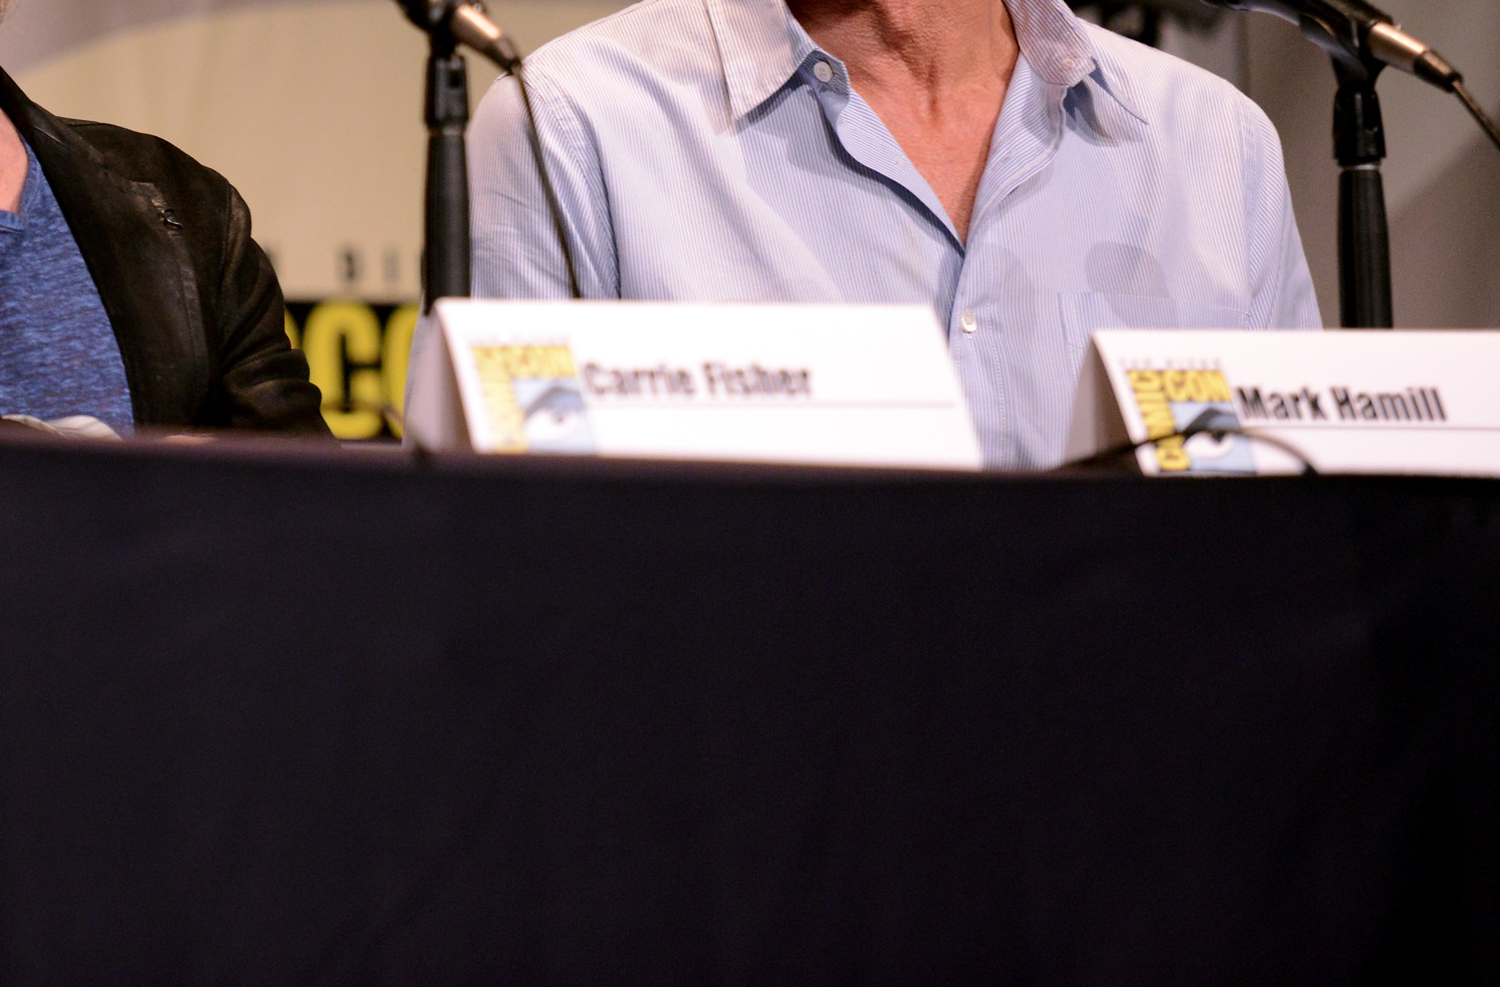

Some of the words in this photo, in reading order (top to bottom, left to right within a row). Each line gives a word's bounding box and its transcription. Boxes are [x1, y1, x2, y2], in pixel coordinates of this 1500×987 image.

[583, 360, 696, 397] Carrie
[703, 360, 813, 400] Fisher
[1235, 384, 1328, 421] Mark
[1329, 385, 1448, 422] Hamill
